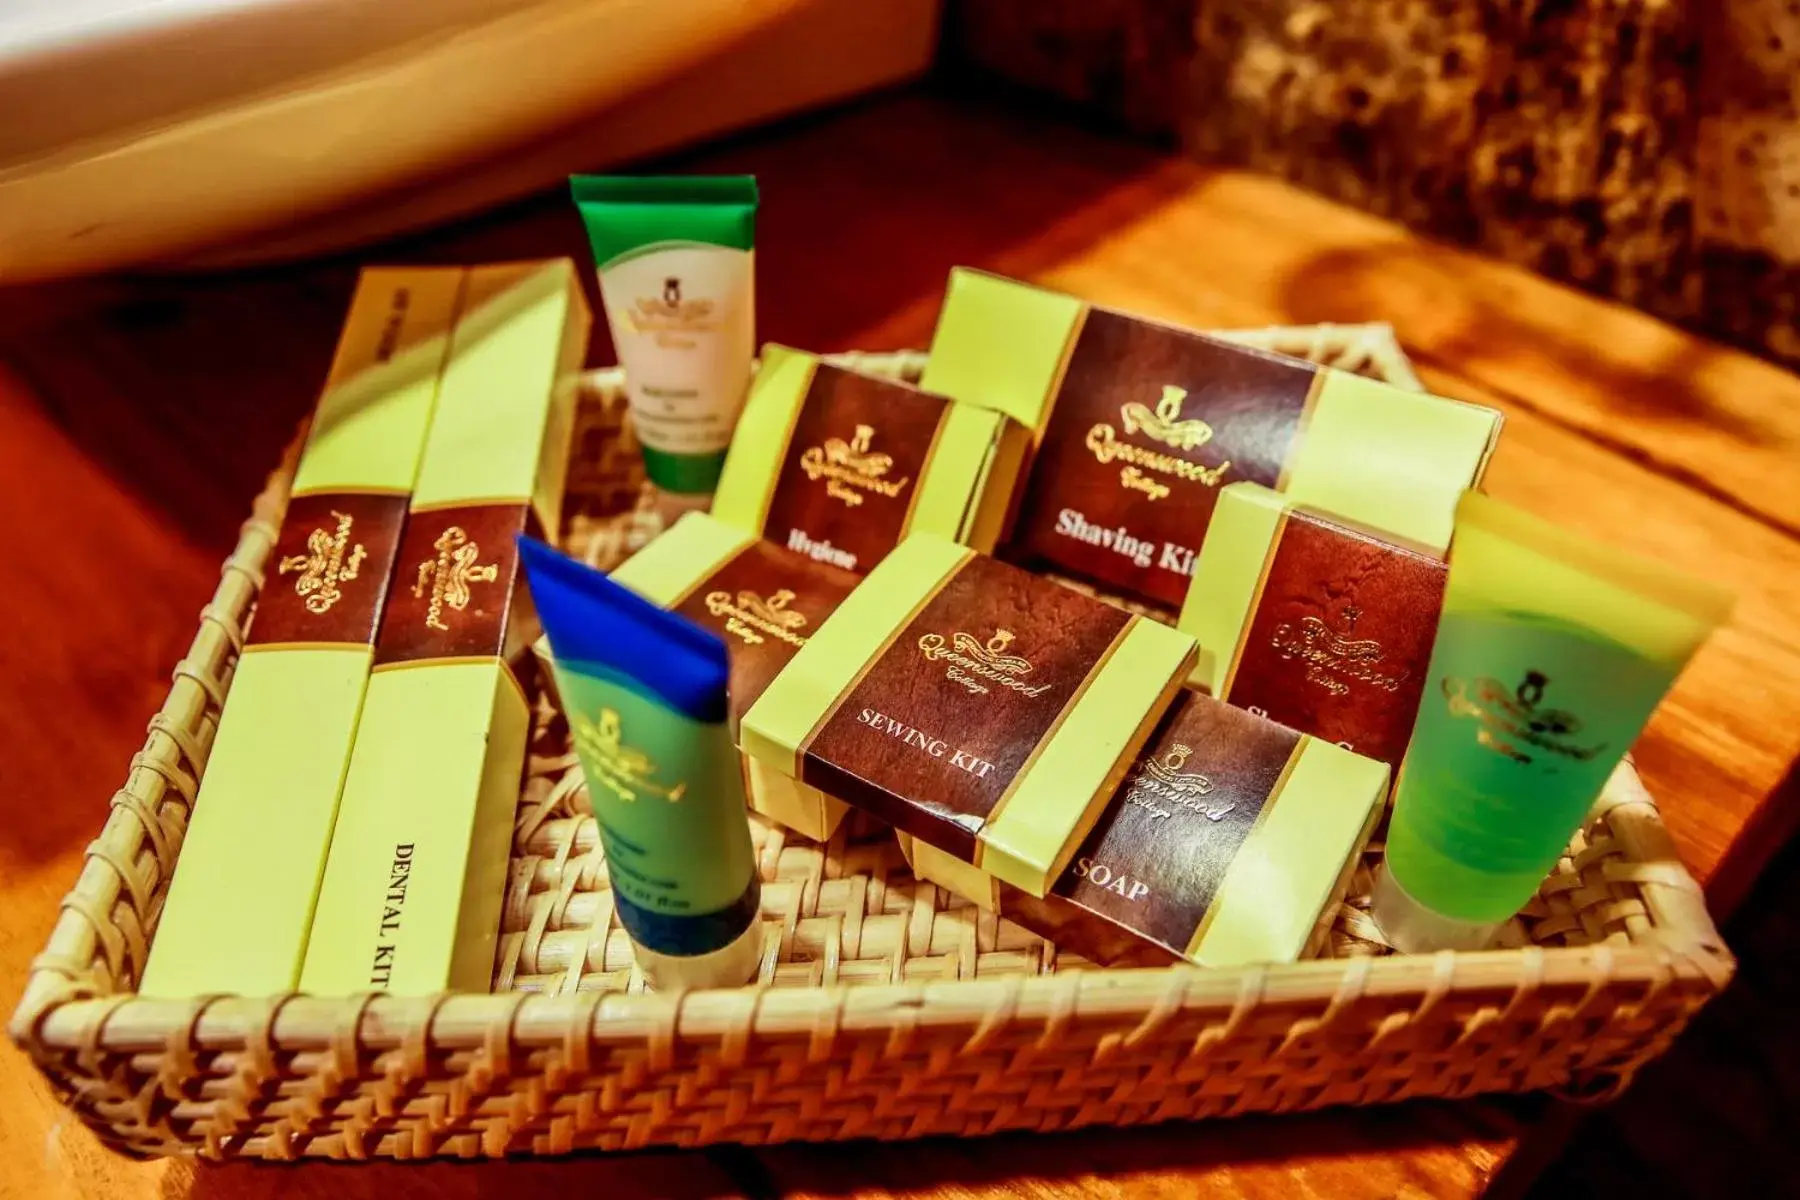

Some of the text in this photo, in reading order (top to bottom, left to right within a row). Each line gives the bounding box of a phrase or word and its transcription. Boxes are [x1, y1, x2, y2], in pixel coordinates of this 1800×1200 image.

[1055, 508, 1155, 568] Shaving
[856, 707, 997, 779] SEWING KIT
[1072, 857, 1150, 902] SOAP
[370, 843, 415, 988] DENTAL KIT
